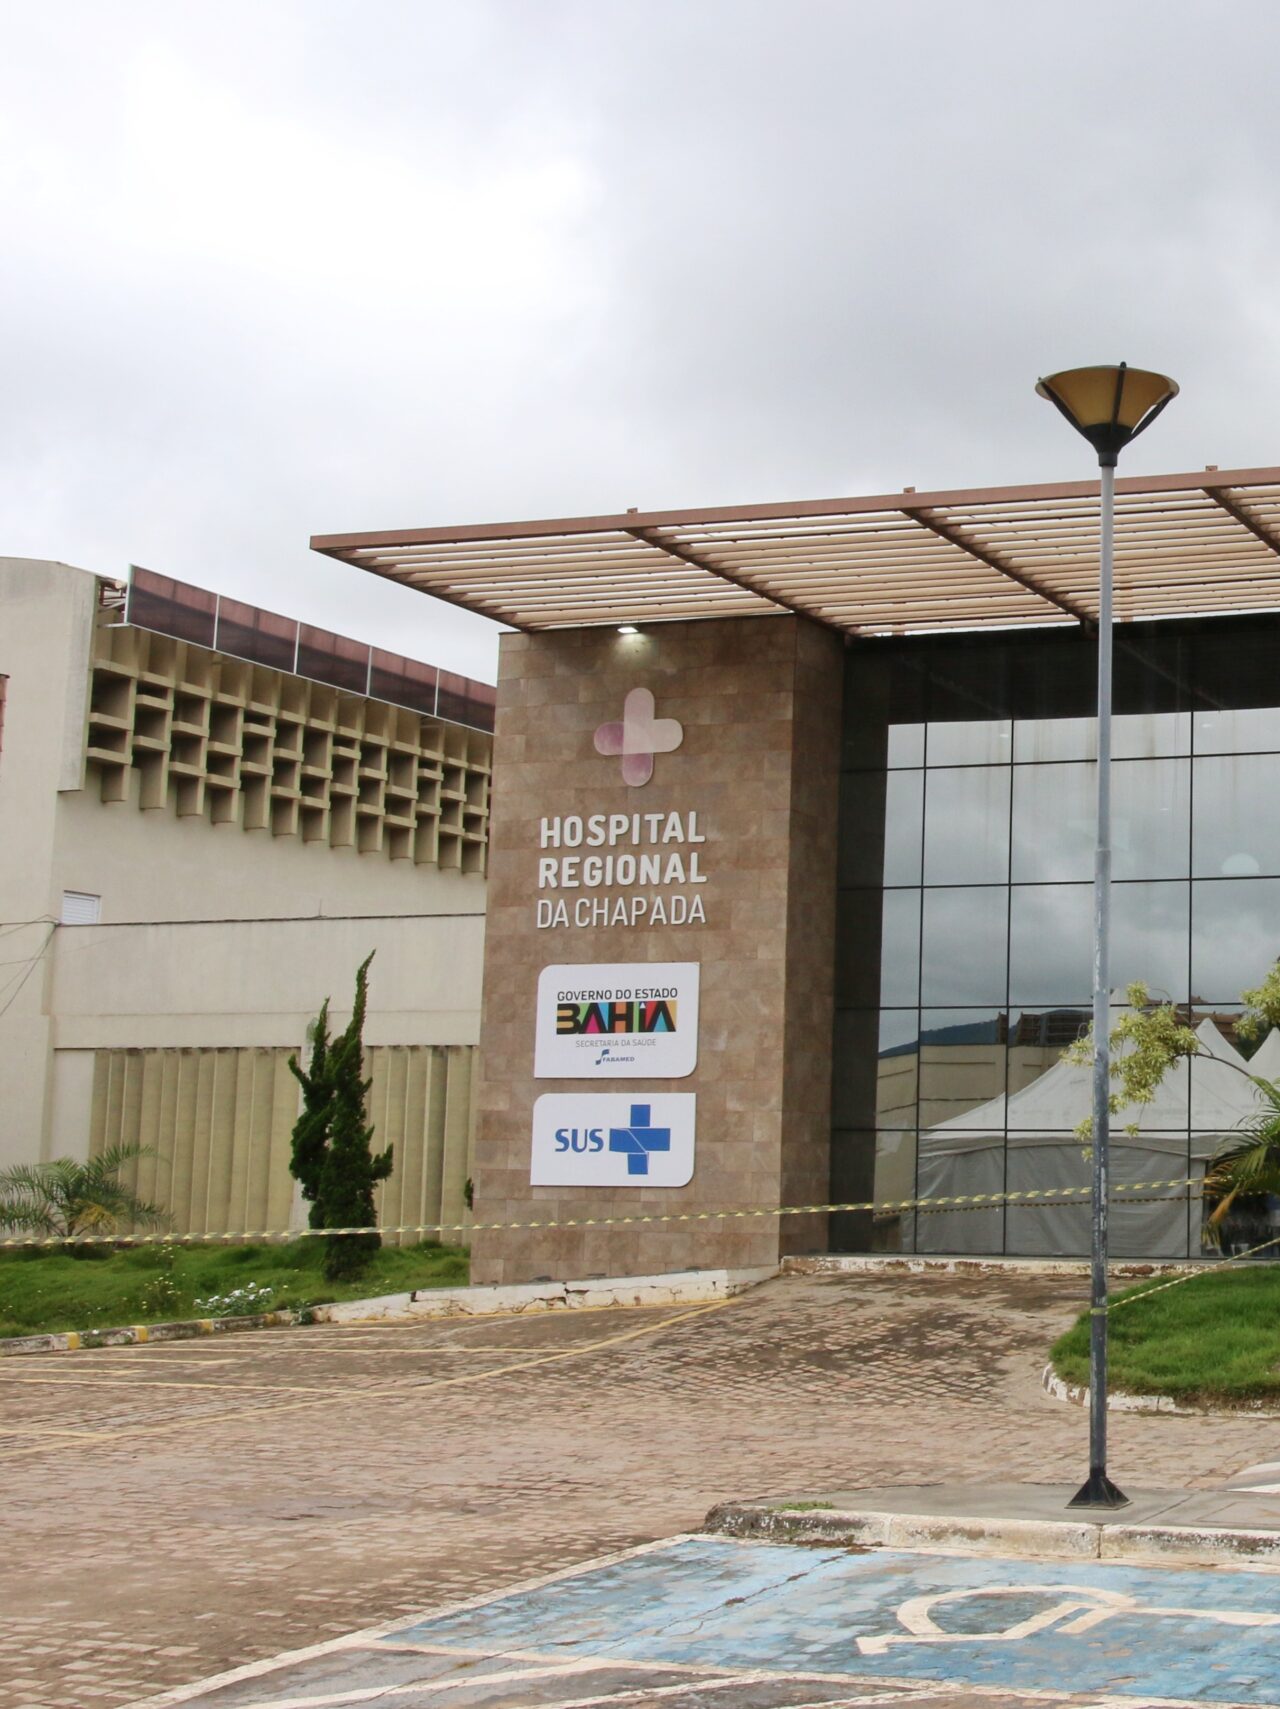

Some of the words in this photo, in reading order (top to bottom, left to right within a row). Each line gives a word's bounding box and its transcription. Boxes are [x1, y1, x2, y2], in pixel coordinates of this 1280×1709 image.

[540, 811, 706, 849] HOSPITAL
[538, 852, 708, 889] REGIONAL
[536, 898, 570, 928] DA
[575, 894, 706, 927] CHAPADA
[557, 989, 612, 1002] GOVERNO
[615, 988, 632, 1000] DO
[635, 987, 678, 999] ESTADO
[556, 1000, 677, 1035] BAHIA
[575, 1039, 619, 1048] SECRETARIA
[555, 1128, 604, 1153] SUS
